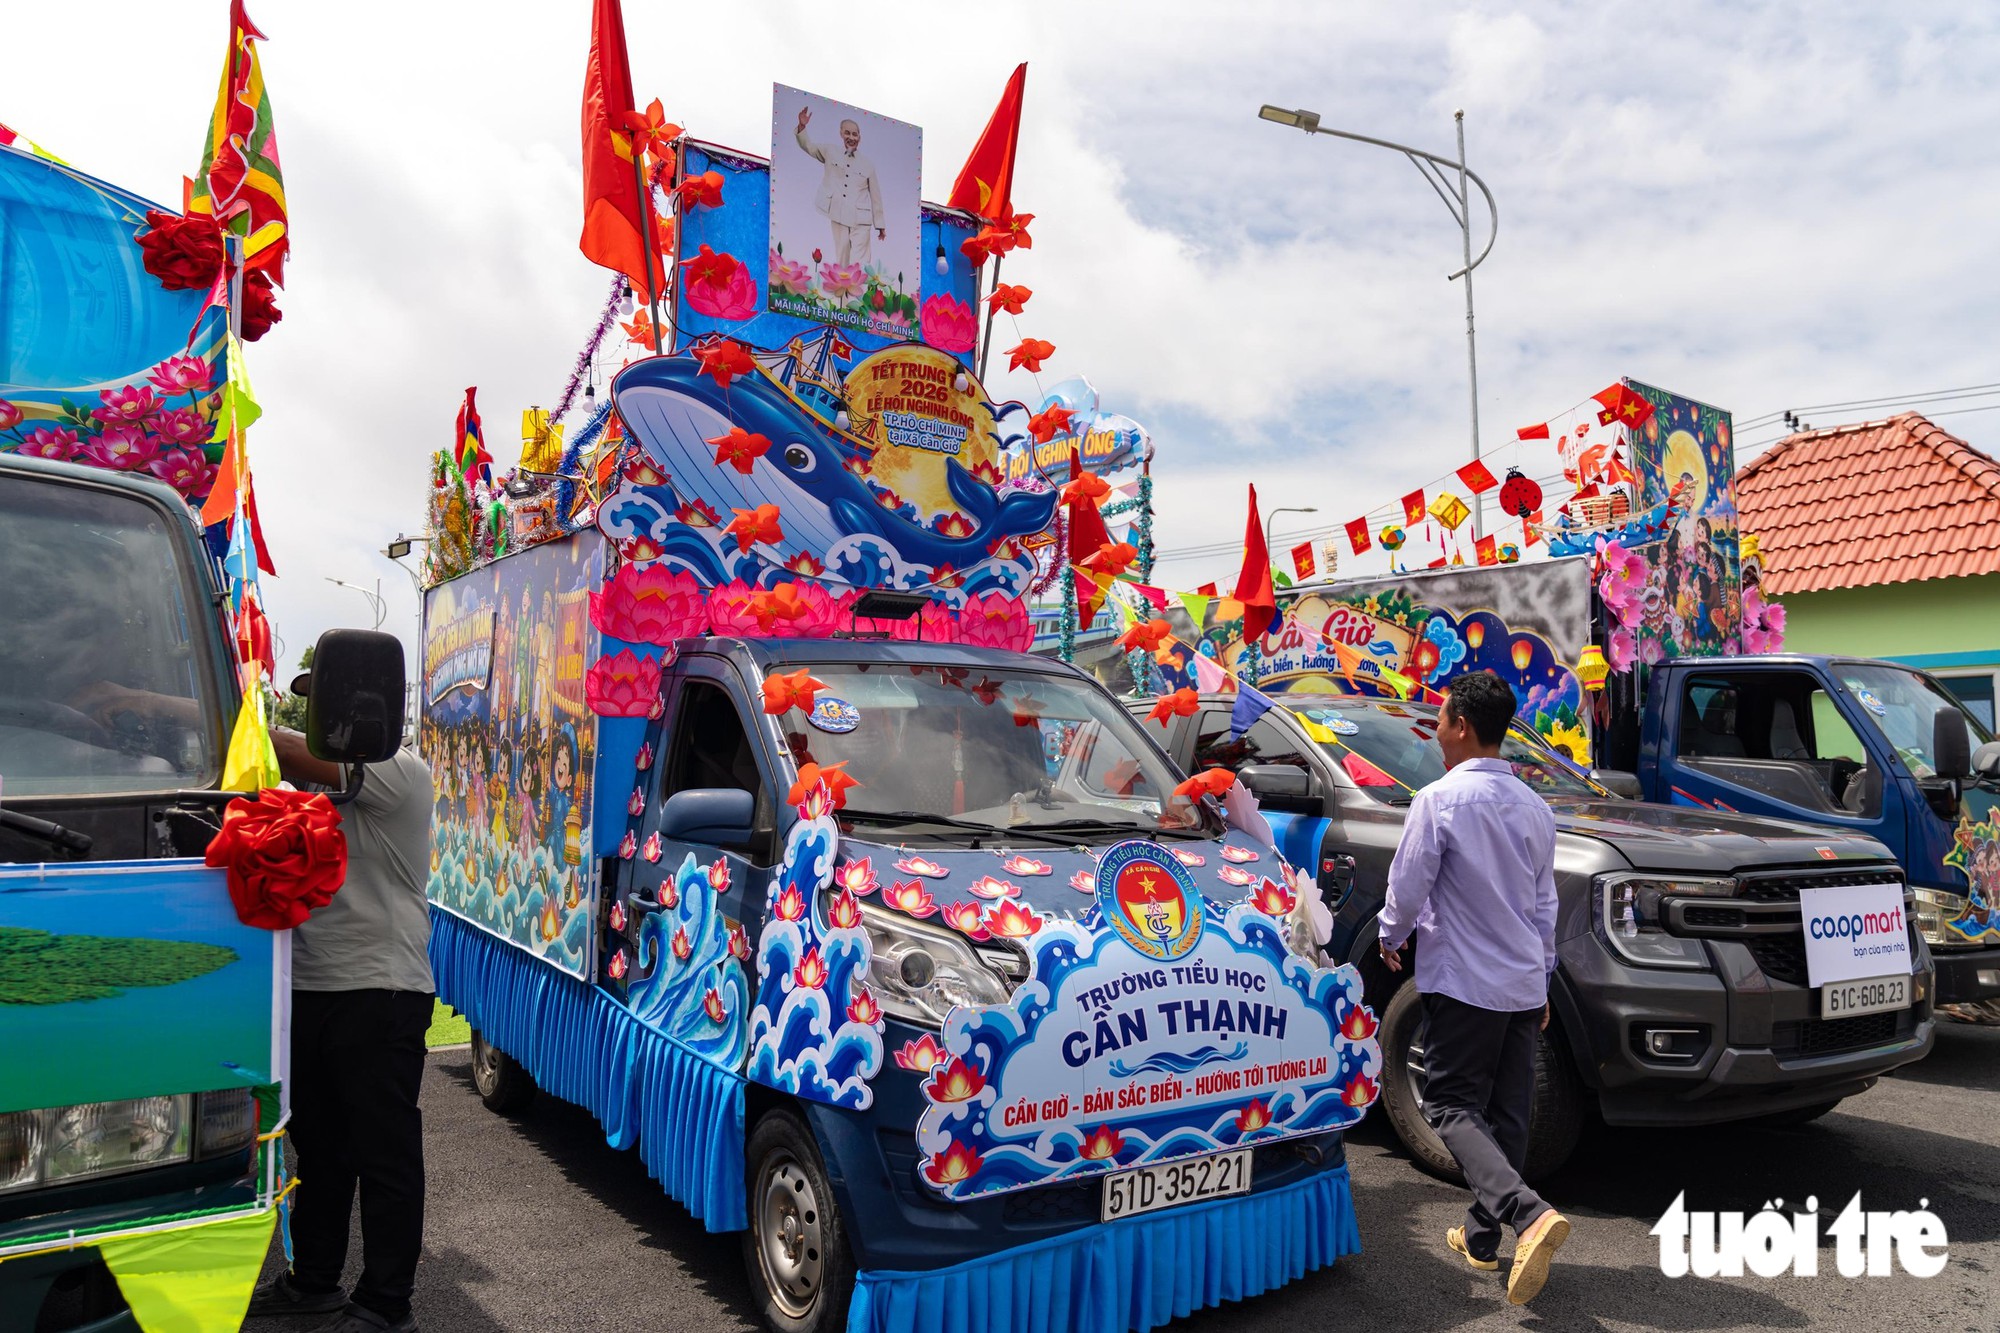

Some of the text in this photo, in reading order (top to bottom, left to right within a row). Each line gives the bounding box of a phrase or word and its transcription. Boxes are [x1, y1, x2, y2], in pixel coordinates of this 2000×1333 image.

[774, 298, 791, 309] MÃI
[793, 303, 810, 314] MÃI
[812, 306, 829, 318] TÊN
[876, 320, 890, 331] CHÍ
[892, 326, 914, 337] MINH
[871, 359, 975, 398] TẾT TRUNG TU
[900, 379, 948, 403] 2026
[867, 391, 975, 431] LỄ HỘI NGHINH ÔNG
[884, 412, 966, 438] TP.HỒ CHÍ MINH
[889, 429, 960, 452] tại Xã Cần Giờ
[1009, 449, 1030, 480] HỘI
[1084, 427, 1115, 458] ÔNG
[1322, 611, 1375, 654] Giờ
[1273, 654, 1293, 673] biển
[819, 700, 843, 719] 13
[1103, 847, 1194, 899] TRƯỜNG TIỂU HỌC CẦN THẠNH
[1810, 905, 1903, 942] co.opmart
[1853, 947, 1867, 958] bạn
[1869, 945, 1881, 955] của
[1882, 943, 1892, 955] mọi
[1076, 958, 1266, 1012] TRƯỜNG TIỂU HỌC
[1062, 999, 1288, 1068] CẦN THẠNH
[1004, 1097, 1037, 1127] CẦN
[1041, 1093, 1069, 1121] GIỜ
[1084, 1088, 1114, 1114] BẢN
[1118, 1080, 1146, 1109] SẮC
[1150, 1073, 1182, 1104] BIỂN
[1196, 1069, 1241, 1096] HƯỚNG
[1244, 1063, 1264, 1087] TỚI
[1266, 1059, 1306, 1083] TƯƠNG
[1309, 1057, 1327, 1076] LAI
[1109, 1155, 1244, 1214] 51D-352.21
